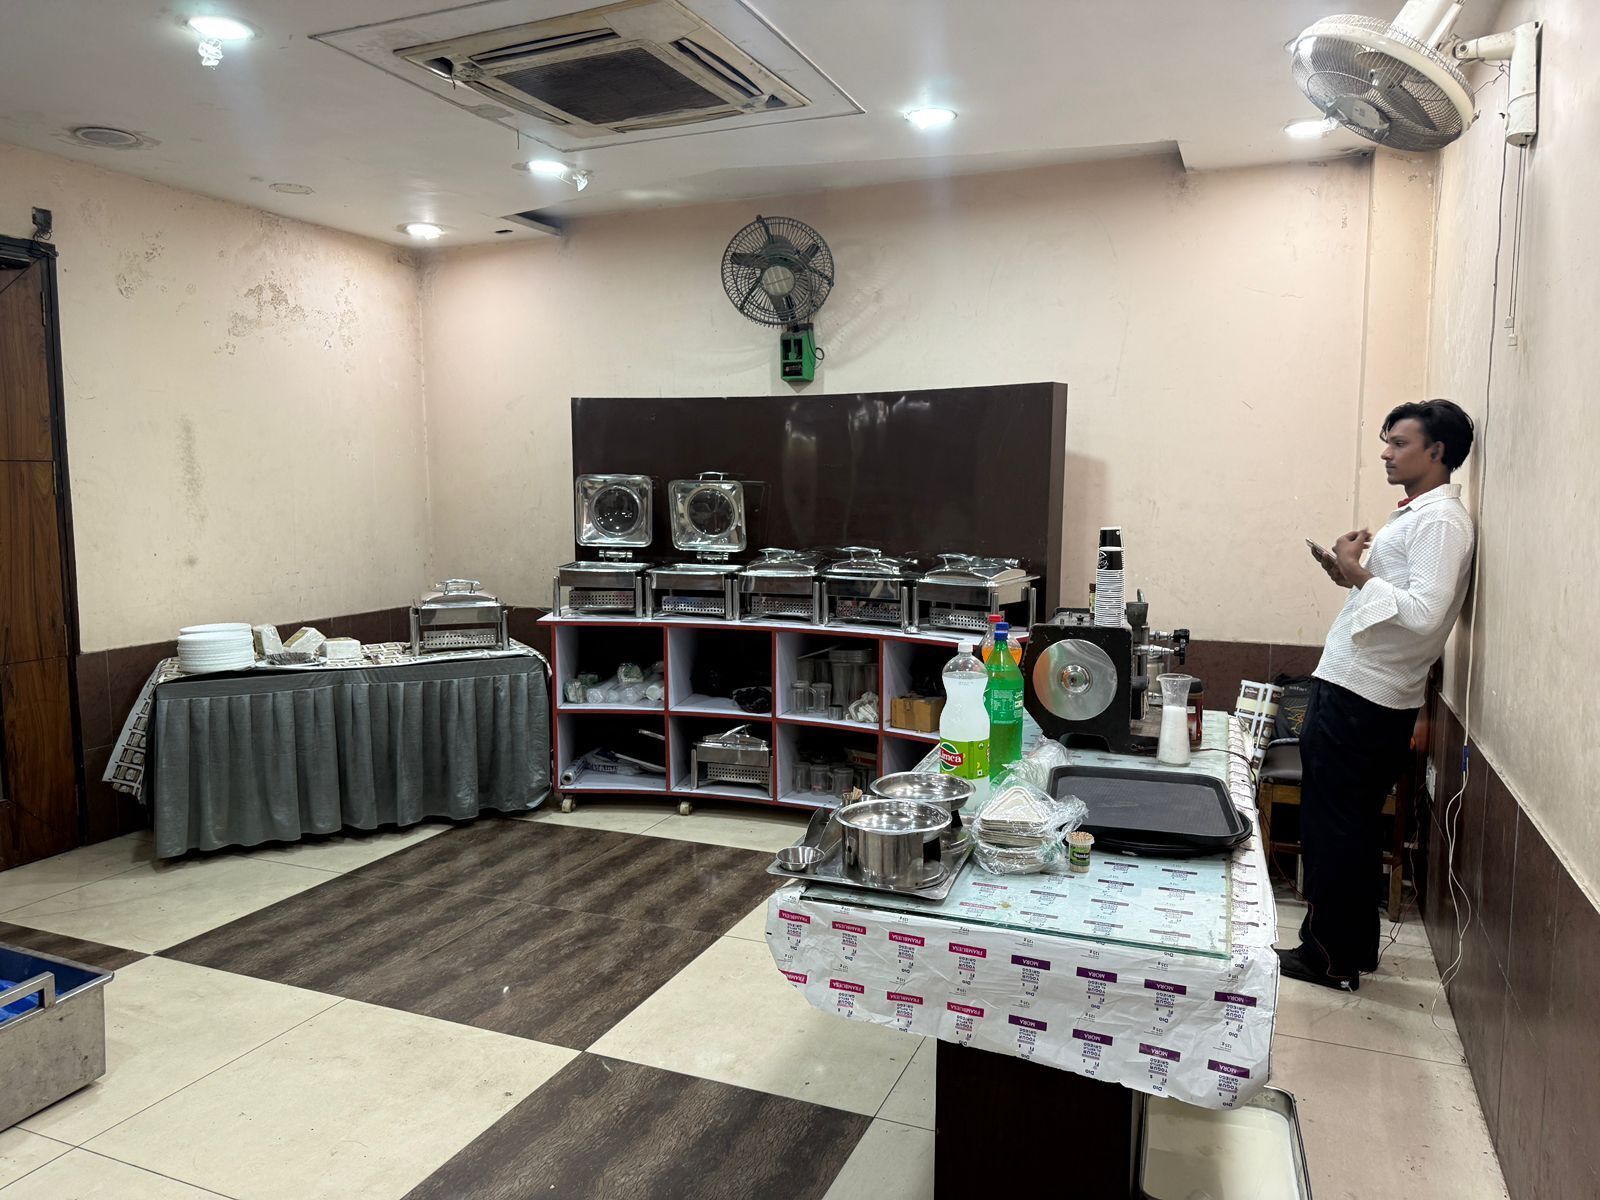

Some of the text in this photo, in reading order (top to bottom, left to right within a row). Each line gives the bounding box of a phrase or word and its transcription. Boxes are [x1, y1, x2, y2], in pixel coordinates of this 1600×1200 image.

[892, 934, 921, 944] FRAMBUESA
[952, 945, 983, 956] FRAMBUESA
[1022, 959, 1039, 967] MORA
[1088, 971, 1105, 979] MORA
[1156, 983, 1174, 991] MORA
[889, 994, 919, 1002] FRAMBUESA
[950, 1004, 980, 1015] FRAMBUESA
[1019, 1019, 1035, 1027] MORA
[1083, 1034, 1100, 1042] MORA
[1151, 1049, 1168, 1057] MORA
[1219, 1064, 1237, 1074] MORA
